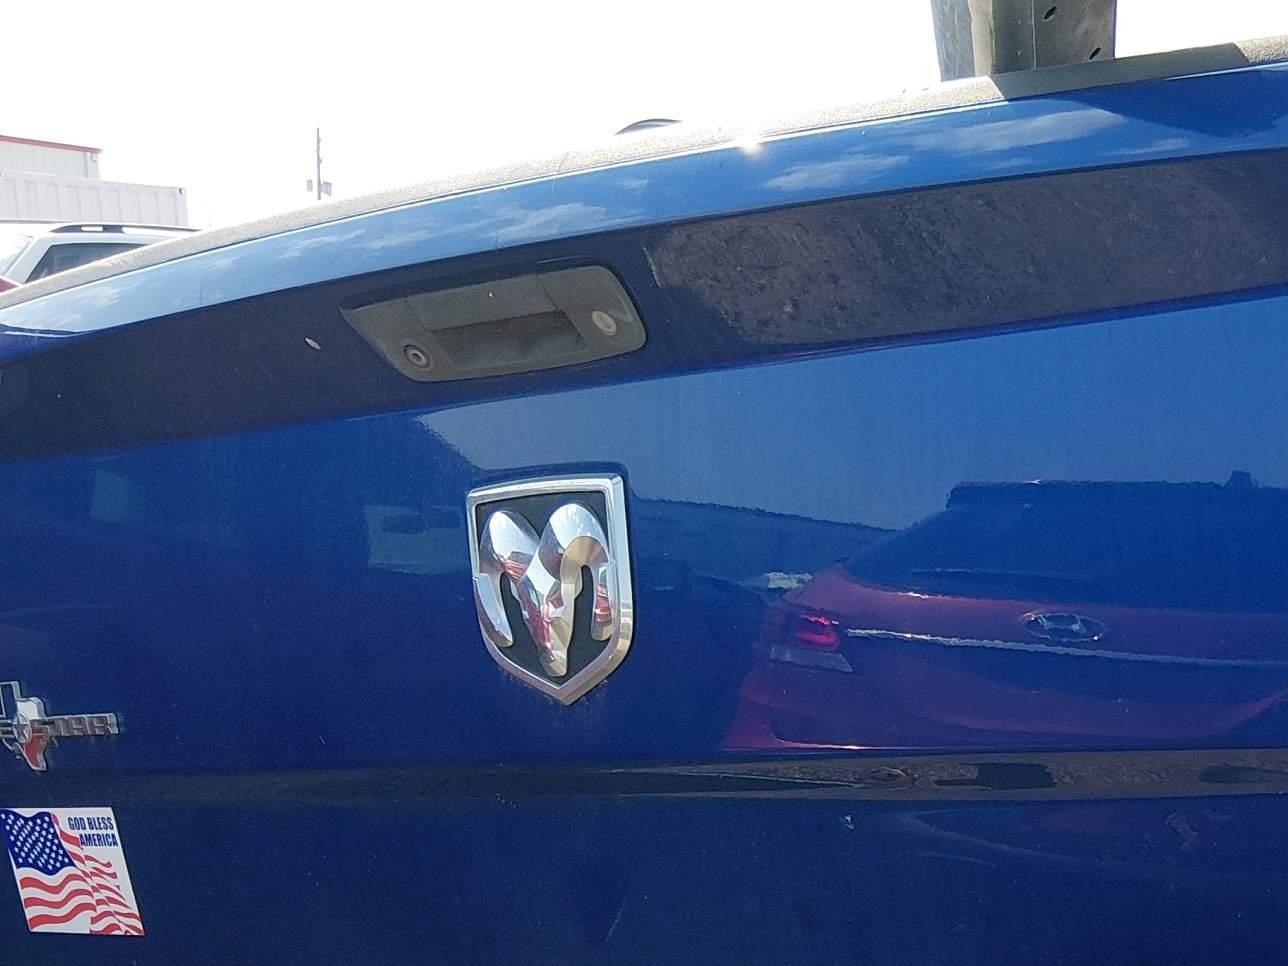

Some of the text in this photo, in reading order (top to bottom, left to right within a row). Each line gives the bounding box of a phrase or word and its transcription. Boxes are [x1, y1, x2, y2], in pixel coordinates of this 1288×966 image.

[67, 816, 114, 831] GOD BLESS
[79, 833, 119, 847] AMERICA
